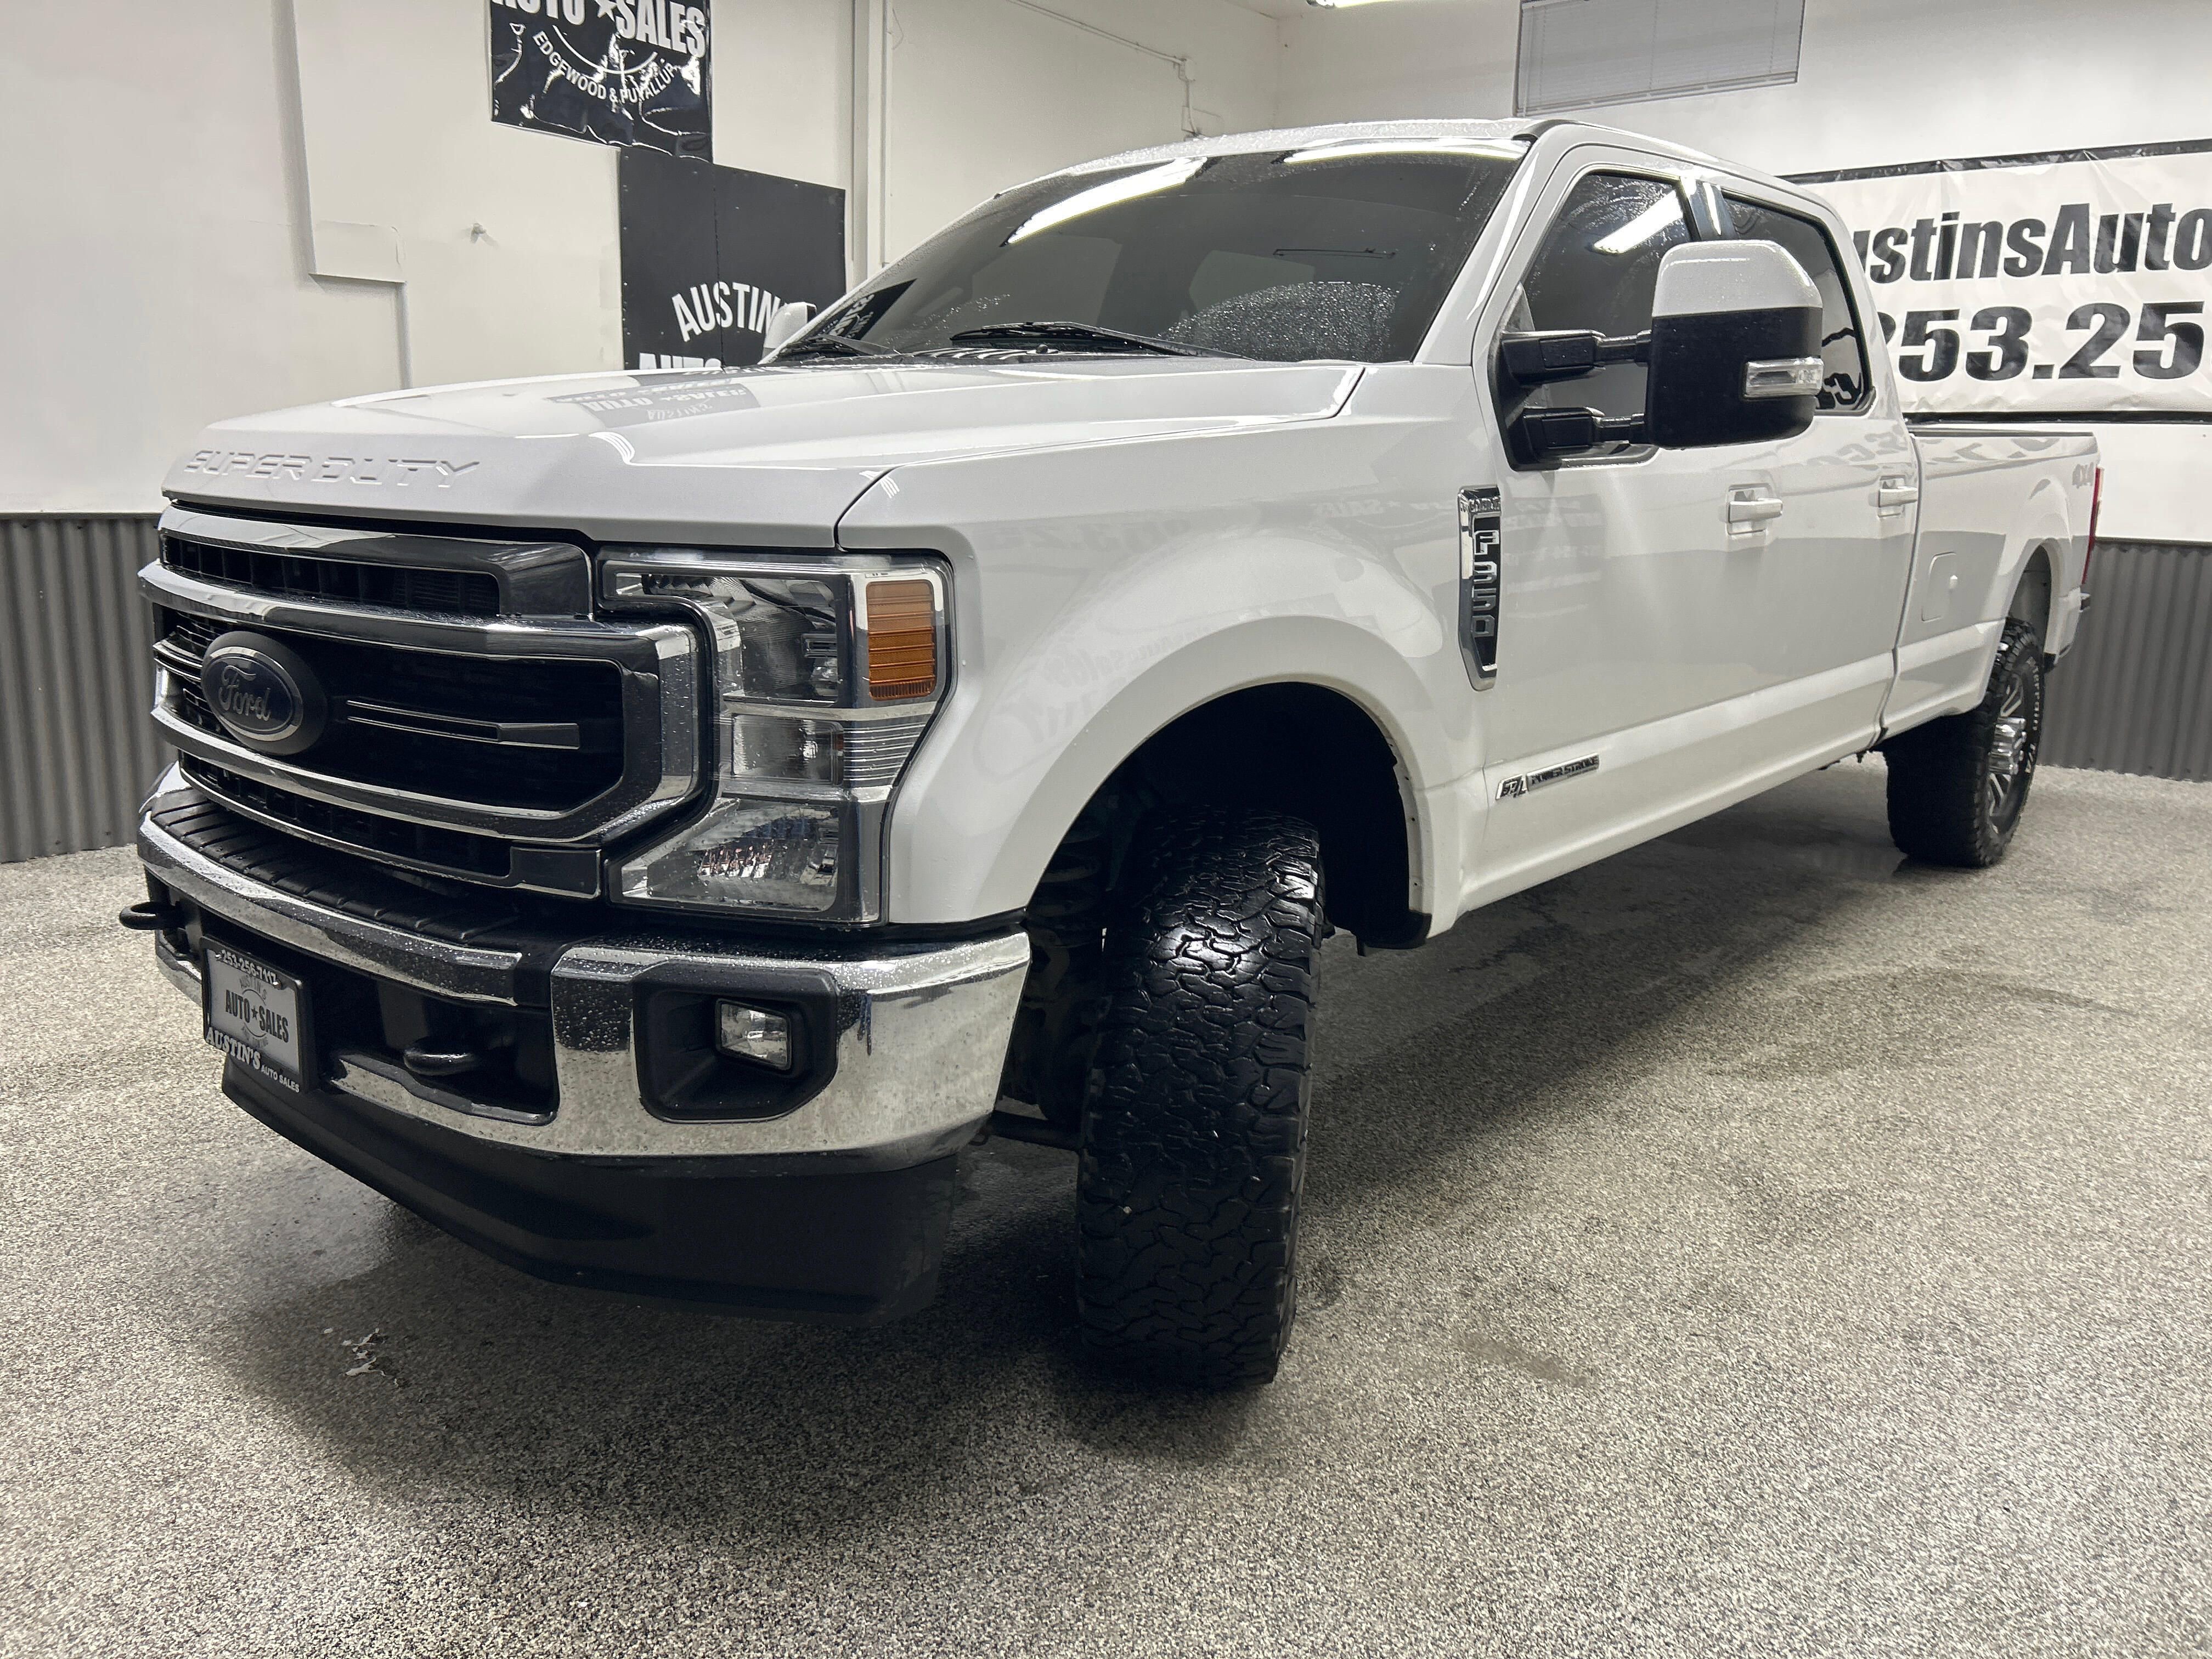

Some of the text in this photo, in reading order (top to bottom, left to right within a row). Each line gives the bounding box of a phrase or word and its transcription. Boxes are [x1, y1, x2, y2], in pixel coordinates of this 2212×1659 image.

[615, 0, 706, 58] SALES
[533, 31, 607, 100] EDGEWOOD
[610, 87, 619, 103] &
[184, 450, 481, 488] SUPER DUTY
[218, 665, 272, 721] Ford
[221, 950, 278, 983] 253-256-7117
[225, 990, 250, 1023] AUTO
[258, 1005, 289, 1043] SALES
[205, 1026, 261, 1070] AUSTIN'S
[261, 1064, 278, 1081] AUTO
[279, 1074, 300, 1093] SALES
